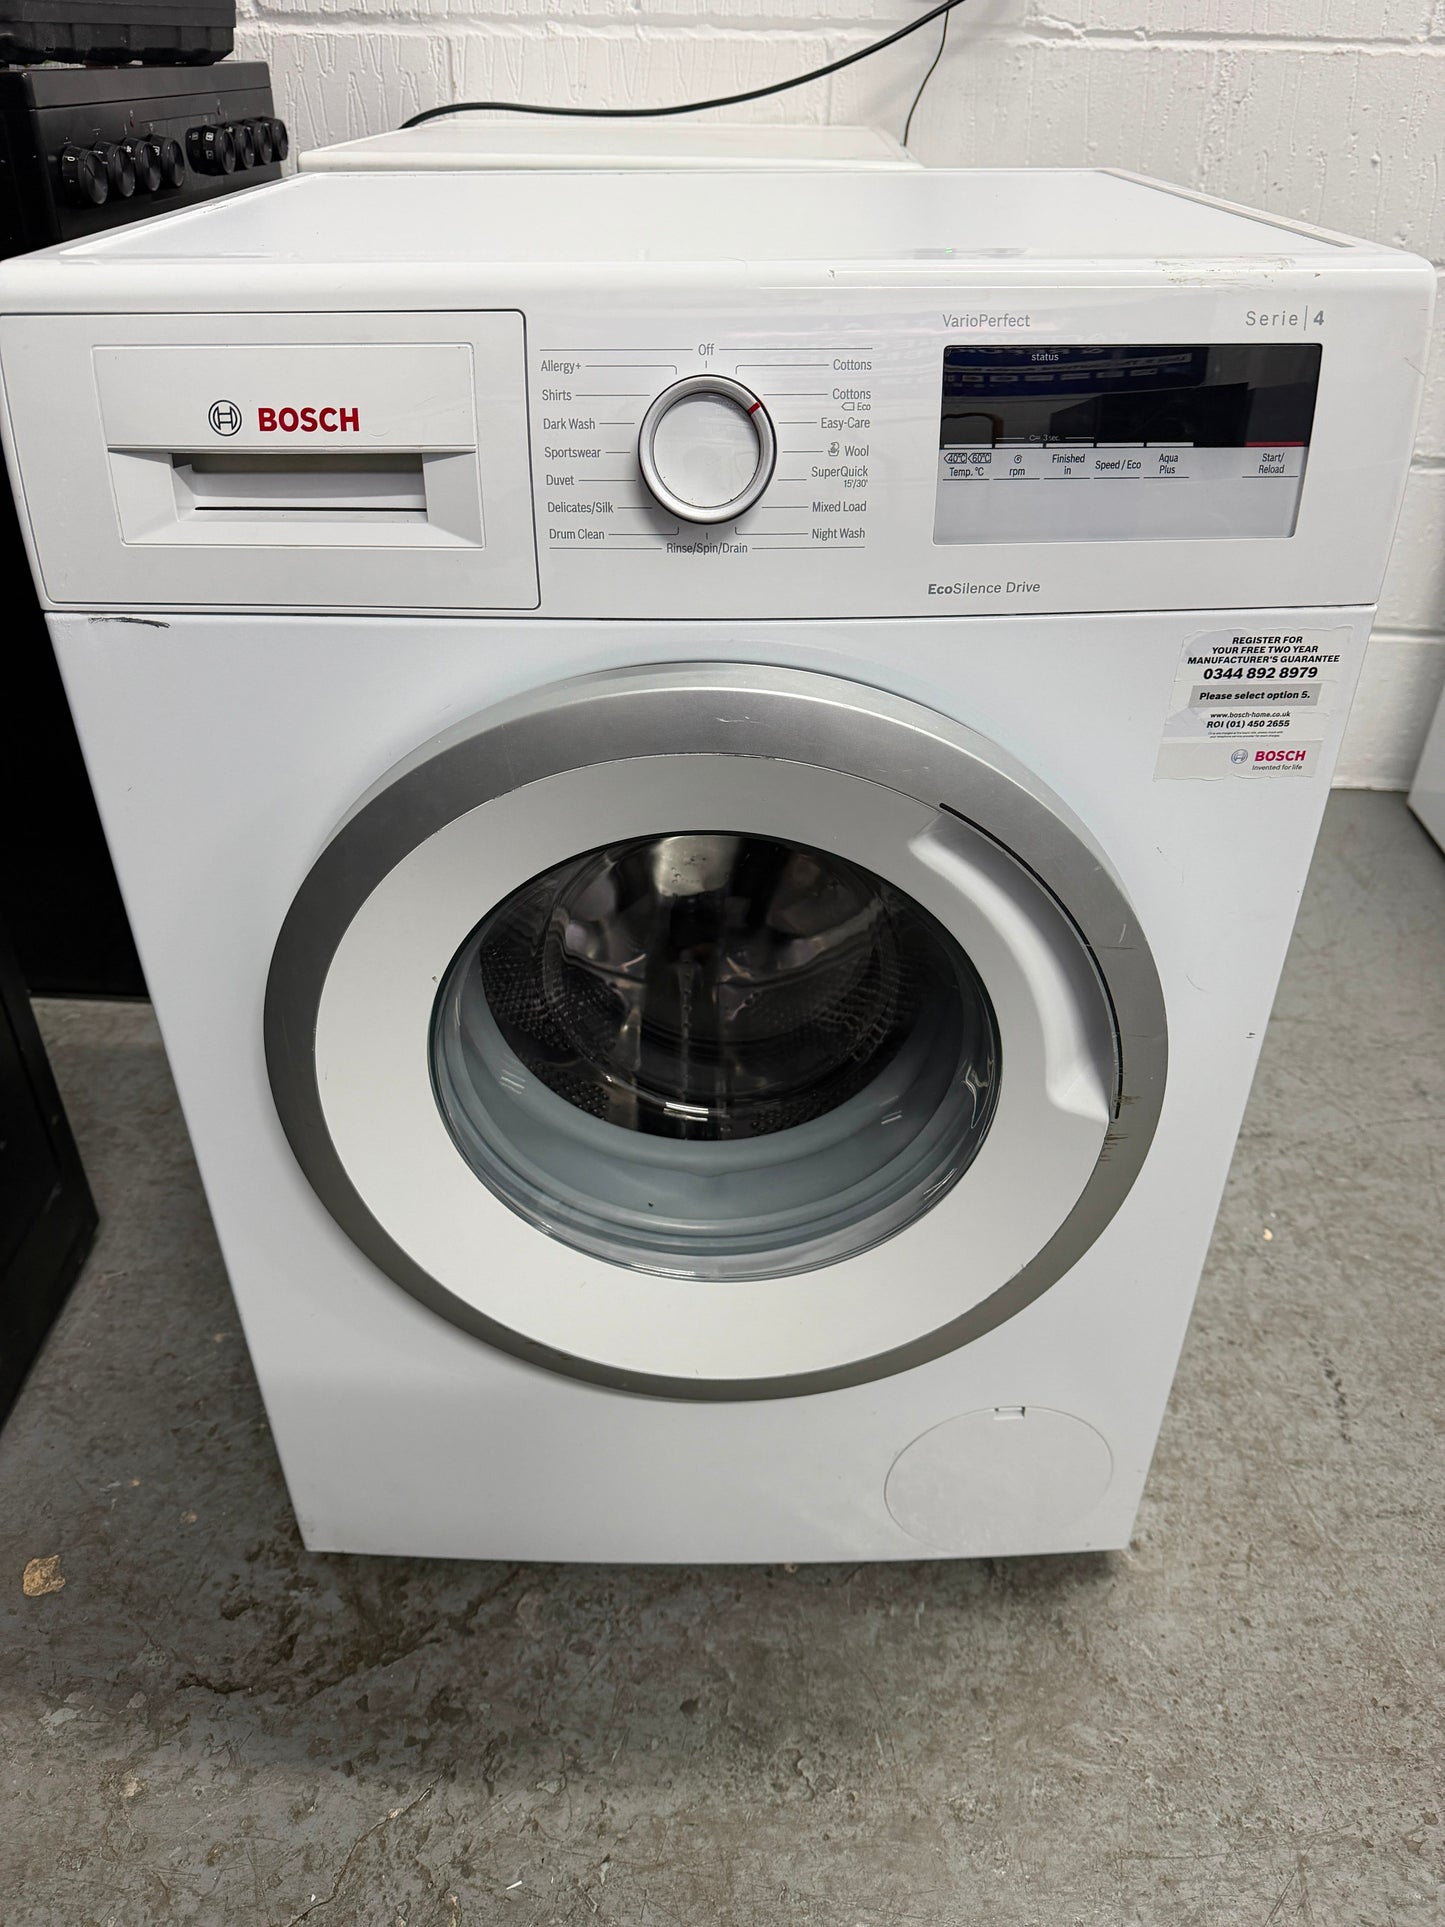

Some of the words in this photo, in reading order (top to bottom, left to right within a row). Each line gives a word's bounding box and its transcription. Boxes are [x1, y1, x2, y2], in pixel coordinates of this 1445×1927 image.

[943, 314, 1030, 328] VarioPerfect
[1246, 311, 1299, 326] Serie
[698, 344, 714, 355] Off
[1032, 352, 1059, 361] status
[541, 360, 581, 374] Allergy+
[833, 359, 872, 371] Cottons
[542, 389, 572, 401] Shirts
[832, 388, 871, 400] Cottons
[857, 403, 871, 411] Eco
[258, 407, 359, 432] BOSCH
[543, 418, 566, 429] Dark
[568, 418, 595, 429] Wash
[821, 417, 870, 430] Easy-Care
[544, 446, 601, 460] Sportswear
[844, 446, 869, 457] Wool
[1052, 454, 1085, 463] Finished
[1159, 454, 1178, 465] Aqua
[1262, 453, 1284, 463] Start/
[1096, 460, 1120, 472] Speed
[1127, 460, 1141, 470] Eco
[1159, 465, 1175, 474] Plus
[1259, 464, 1285, 474] Reload
[812, 466, 868, 479] SuperQuick
[950, 468, 973, 477] Temp.
[975, 467, 984, 476] °C
[546, 475, 574, 486] Duvet
[547, 502, 614, 513] Delicates/Silk
[812, 501, 840, 512] Mixed
[843, 501, 866, 512] Load
[549, 529, 575, 540] Drum
[576, 529, 605, 540] Clean
[812, 528, 837, 541] Night
[839, 528, 865, 539] Wash
[666, 542, 748, 556] Rinse/Spin/Drain
[928, 583, 1001, 594] EcoSilence
[1006, 581, 1040, 593] Drive
[1233, 636, 1281, 644] REGISTER
[1241, 646, 1266, 654] FREE
[1188, 656, 1278, 664] MANUFACTURER'S
[1280, 655, 1340, 663] GUARANTEE
[1204, 668, 1243, 680] 0344
[1246, 668, 1275, 679] 892
[1278, 667, 1318, 678] 8979
[1200, 692, 1232, 700] Please
[1267, 691, 1299, 700] option
[1226, 720, 1245, 729] (01)
[1255, 750, 1306, 761] BOSCH
